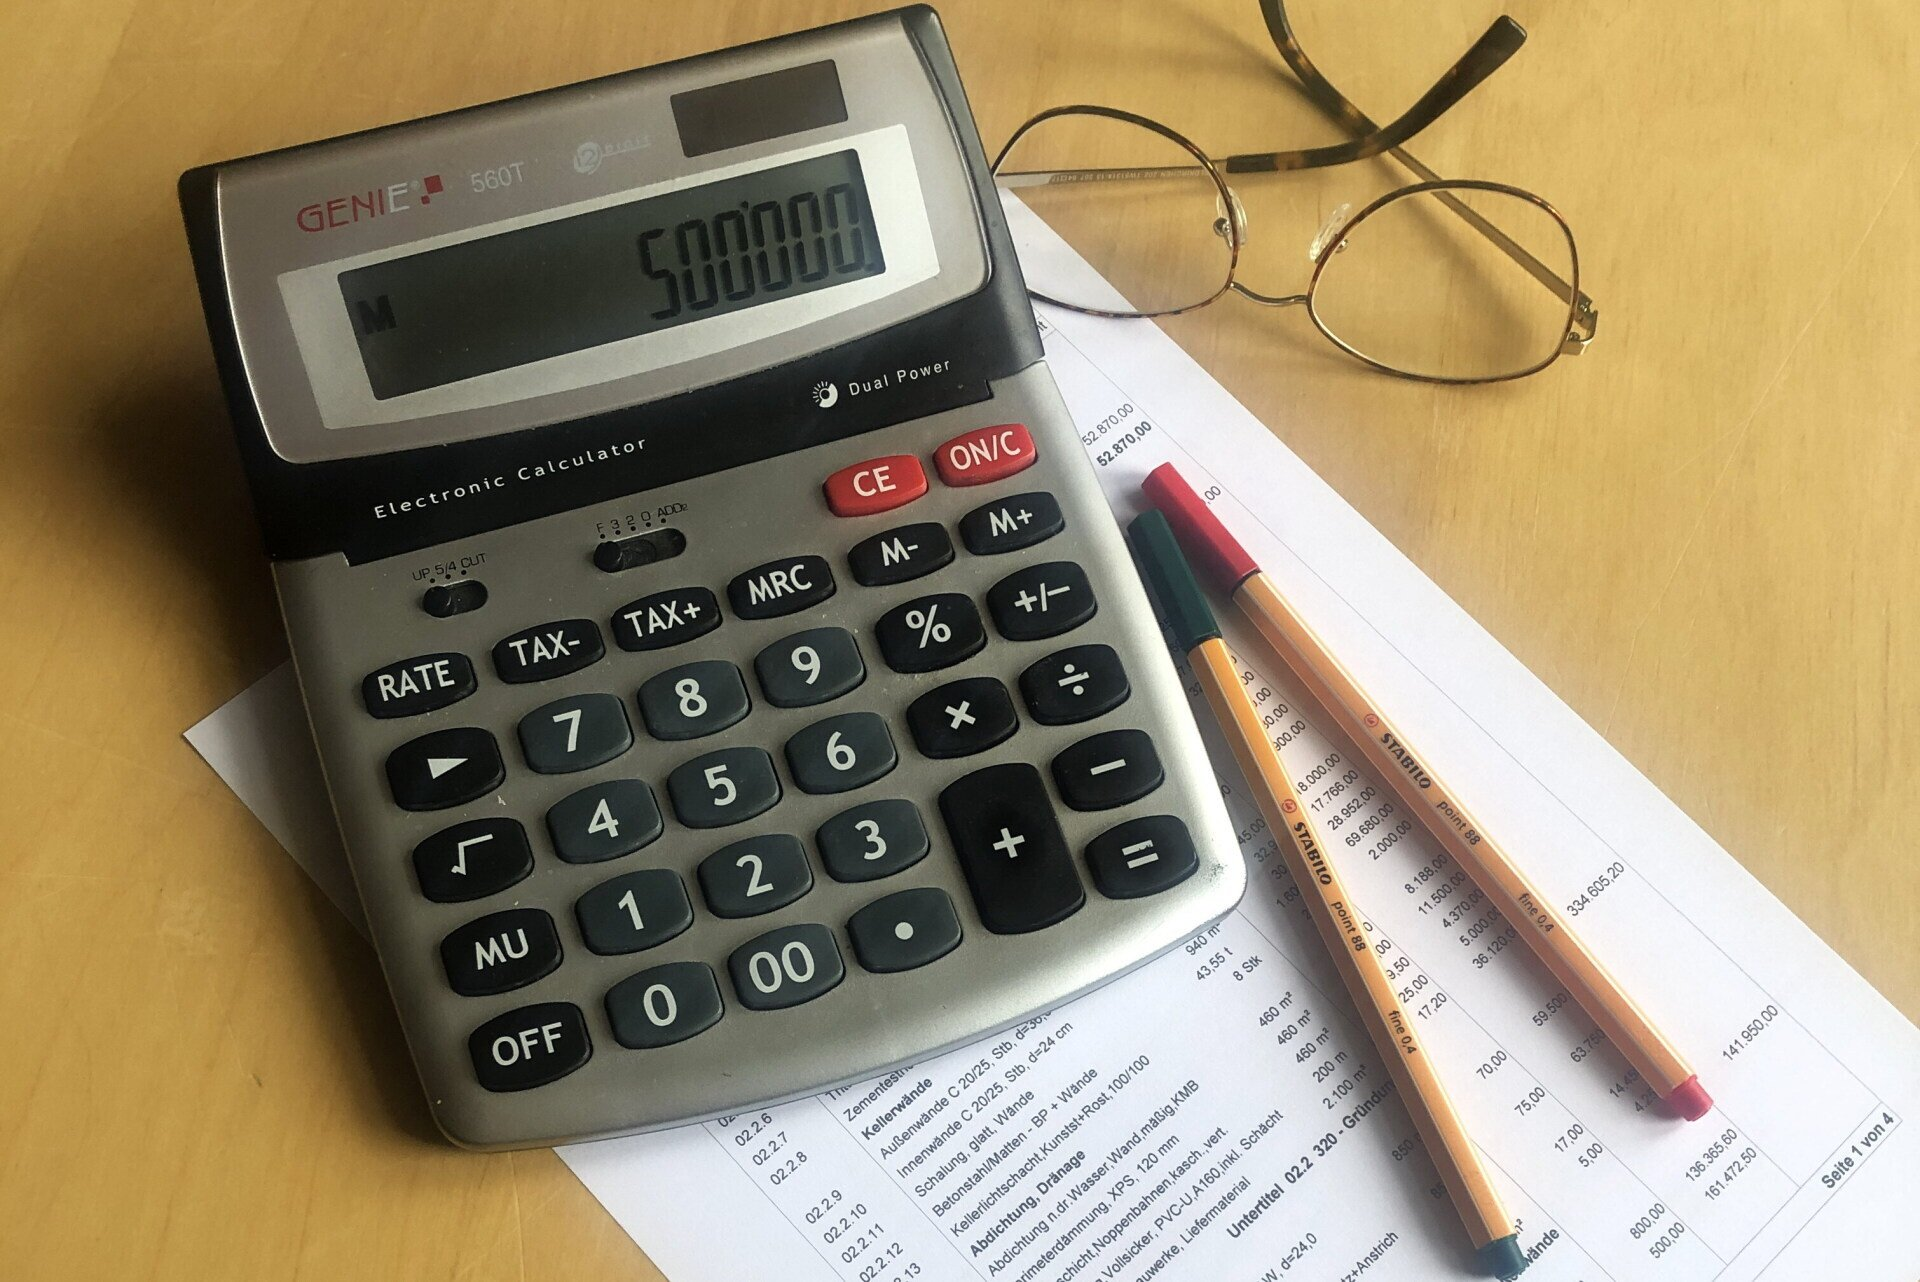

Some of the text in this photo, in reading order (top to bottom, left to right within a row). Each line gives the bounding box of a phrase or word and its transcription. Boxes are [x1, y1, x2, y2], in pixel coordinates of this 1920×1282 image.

[470, 162, 525, 194] 560T
[357, 295, 397, 335] M
[849, 359, 951, 396] Dual Power
[1081, 403, 1134, 446] 52.870,00
[1096, 421, 1152, 467] 52.870,00
[949, 430, 1022, 471] ON/C
[374, 437, 647, 519] Electronic Calculator
[852, 465, 897, 497] CE
[611, 519, 620, 529] 3
[626, 515, 636, 526] 2
[989, 508, 1034, 537] M+
[412, 552, 487, 582] UP 5/4 CUT
[881, 537, 919, 567] M-
[747, 564, 812, 606] MRC
[624, 600, 701, 638] TAX+
[904, 604, 951, 649] %
[508, 630, 581, 667] TAX-
[790, 645, 821, 685] 9
[377, 659, 455, 702] RATE
[674, 677, 707, 718] 8
[553, 709, 582, 753] 7
[825, 731, 857, 771] 6
[703, 764, 737, 806] 5
[1311, 770, 1358, 812] 17.766,00
[587, 798, 619, 838] 4
[1327, 786, 1376, 831] 28.952,00
[1345, 803, 1394, 847] 69.680,00
[1380, 733, 1431, 789] STABILO
[1436, 801, 1467, 831] point
[1464, 829, 1481, 845] 88
[1518, 892, 1538, 916] fine
[854, 819, 887, 860] 3
[1368, 820, 1412, 861] 2.000,00
[735, 854, 774, 897] 2
[1404, 854, 1448, 894] 8.188,00
[1418, 871, 1466, 915] 11.500,00
[1566, 861, 1624, 917] 334.605,20
[617, 890, 645, 930] 1
[1442, 884, 1486, 928] 4.370,00
[474, 928, 529, 970] MU
[1293, 822, 1332, 885] STABILO
[1330, 901, 1356, 934] point
[1351, 935, 1366, 952] 88
[1388, 1010, 1405, 1035] fine
[748, 940, 815, 993] 00
[1196, 947, 1233, 980] 43,55 t
[1233, 955, 1263, 981] 8 Stk
[642, 983, 678, 1027] 0
[1398, 974, 1428, 1003] 25,00
[1418, 992, 1447, 1020] 17,20
[1259, 1006, 1280, 1027] 460
[1277, 1024, 1298, 1045] 460
[1723, 1005, 1778, 1061] 141.950,00
[492, 1021, 563, 1066] OFF
[1296, 1042, 1317, 1063] 460
[1312, 1051, 1348, 1083] 200 m
[1476, 1050, 1507, 1079] 70,00
[861, 1079, 933, 1141] Kellerwände
[896, 1121, 962, 1179] Innenwände
[961, 1109, 973, 1121] C
[1028, 1036, 1056, 1063] d=24
[1055, 1023, 1073, 1039] cm
[993, 1091, 1034, 1126] Wände
[1322, 1079, 1354, 1110] 2.100
[1514, 1087, 1545, 1116] 75,00
[735, 1112, 772, 1146] 02.2.6
[880, 1097, 949, 1160] Außenwände
[948, 1086, 960, 1098] C
[932, 1132, 1028, 1218] Betonstahl/Matten
[1031, 1109, 1048, 1128] BP
[1056, 1069, 1098, 1103] Wände
[1240, 1109, 1284, 1150] Schächt
[1554, 1123, 1584, 1152] 17,00
[752, 1131, 787, 1166] 02.2.7
[770, 1151, 807, 1185] 02.2.8
[1137, 1153, 1159, 1173] 120
[1157, 1135, 1180, 1156] mm
[1578, 1143, 1603, 1167] 5,00
[1685, 1128, 1737, 1181] 136.365,60
[1821, 1112, 1894, 1189] Seite 1 von 4
[1036, 1151, 1085, 1195] Dränage
[1226, 1183, 1285, 1238] Untertitel
[1284, 1156, 1314, 1184] 02.2
[1313, 1133, 1338, 1157] 320
[1705, 1147, 1757, 1200] 161.472,50
[805, 1189, 842, 1224] 02.2.9
[823, 1203, 867, 1244] 02.2.10
[1179, 1176, 1251, 1244] Liefermaterial
[1630, 1203, 1665, 1239] 800,00
[841, 1223, 884, 1263] 02.2.11
[987, 1218, 1050, 1277] Abdichtung
[1281, 1233, 1317, 1270] d=24,0
[1649, 1222, 1685, 1259] 500,00
